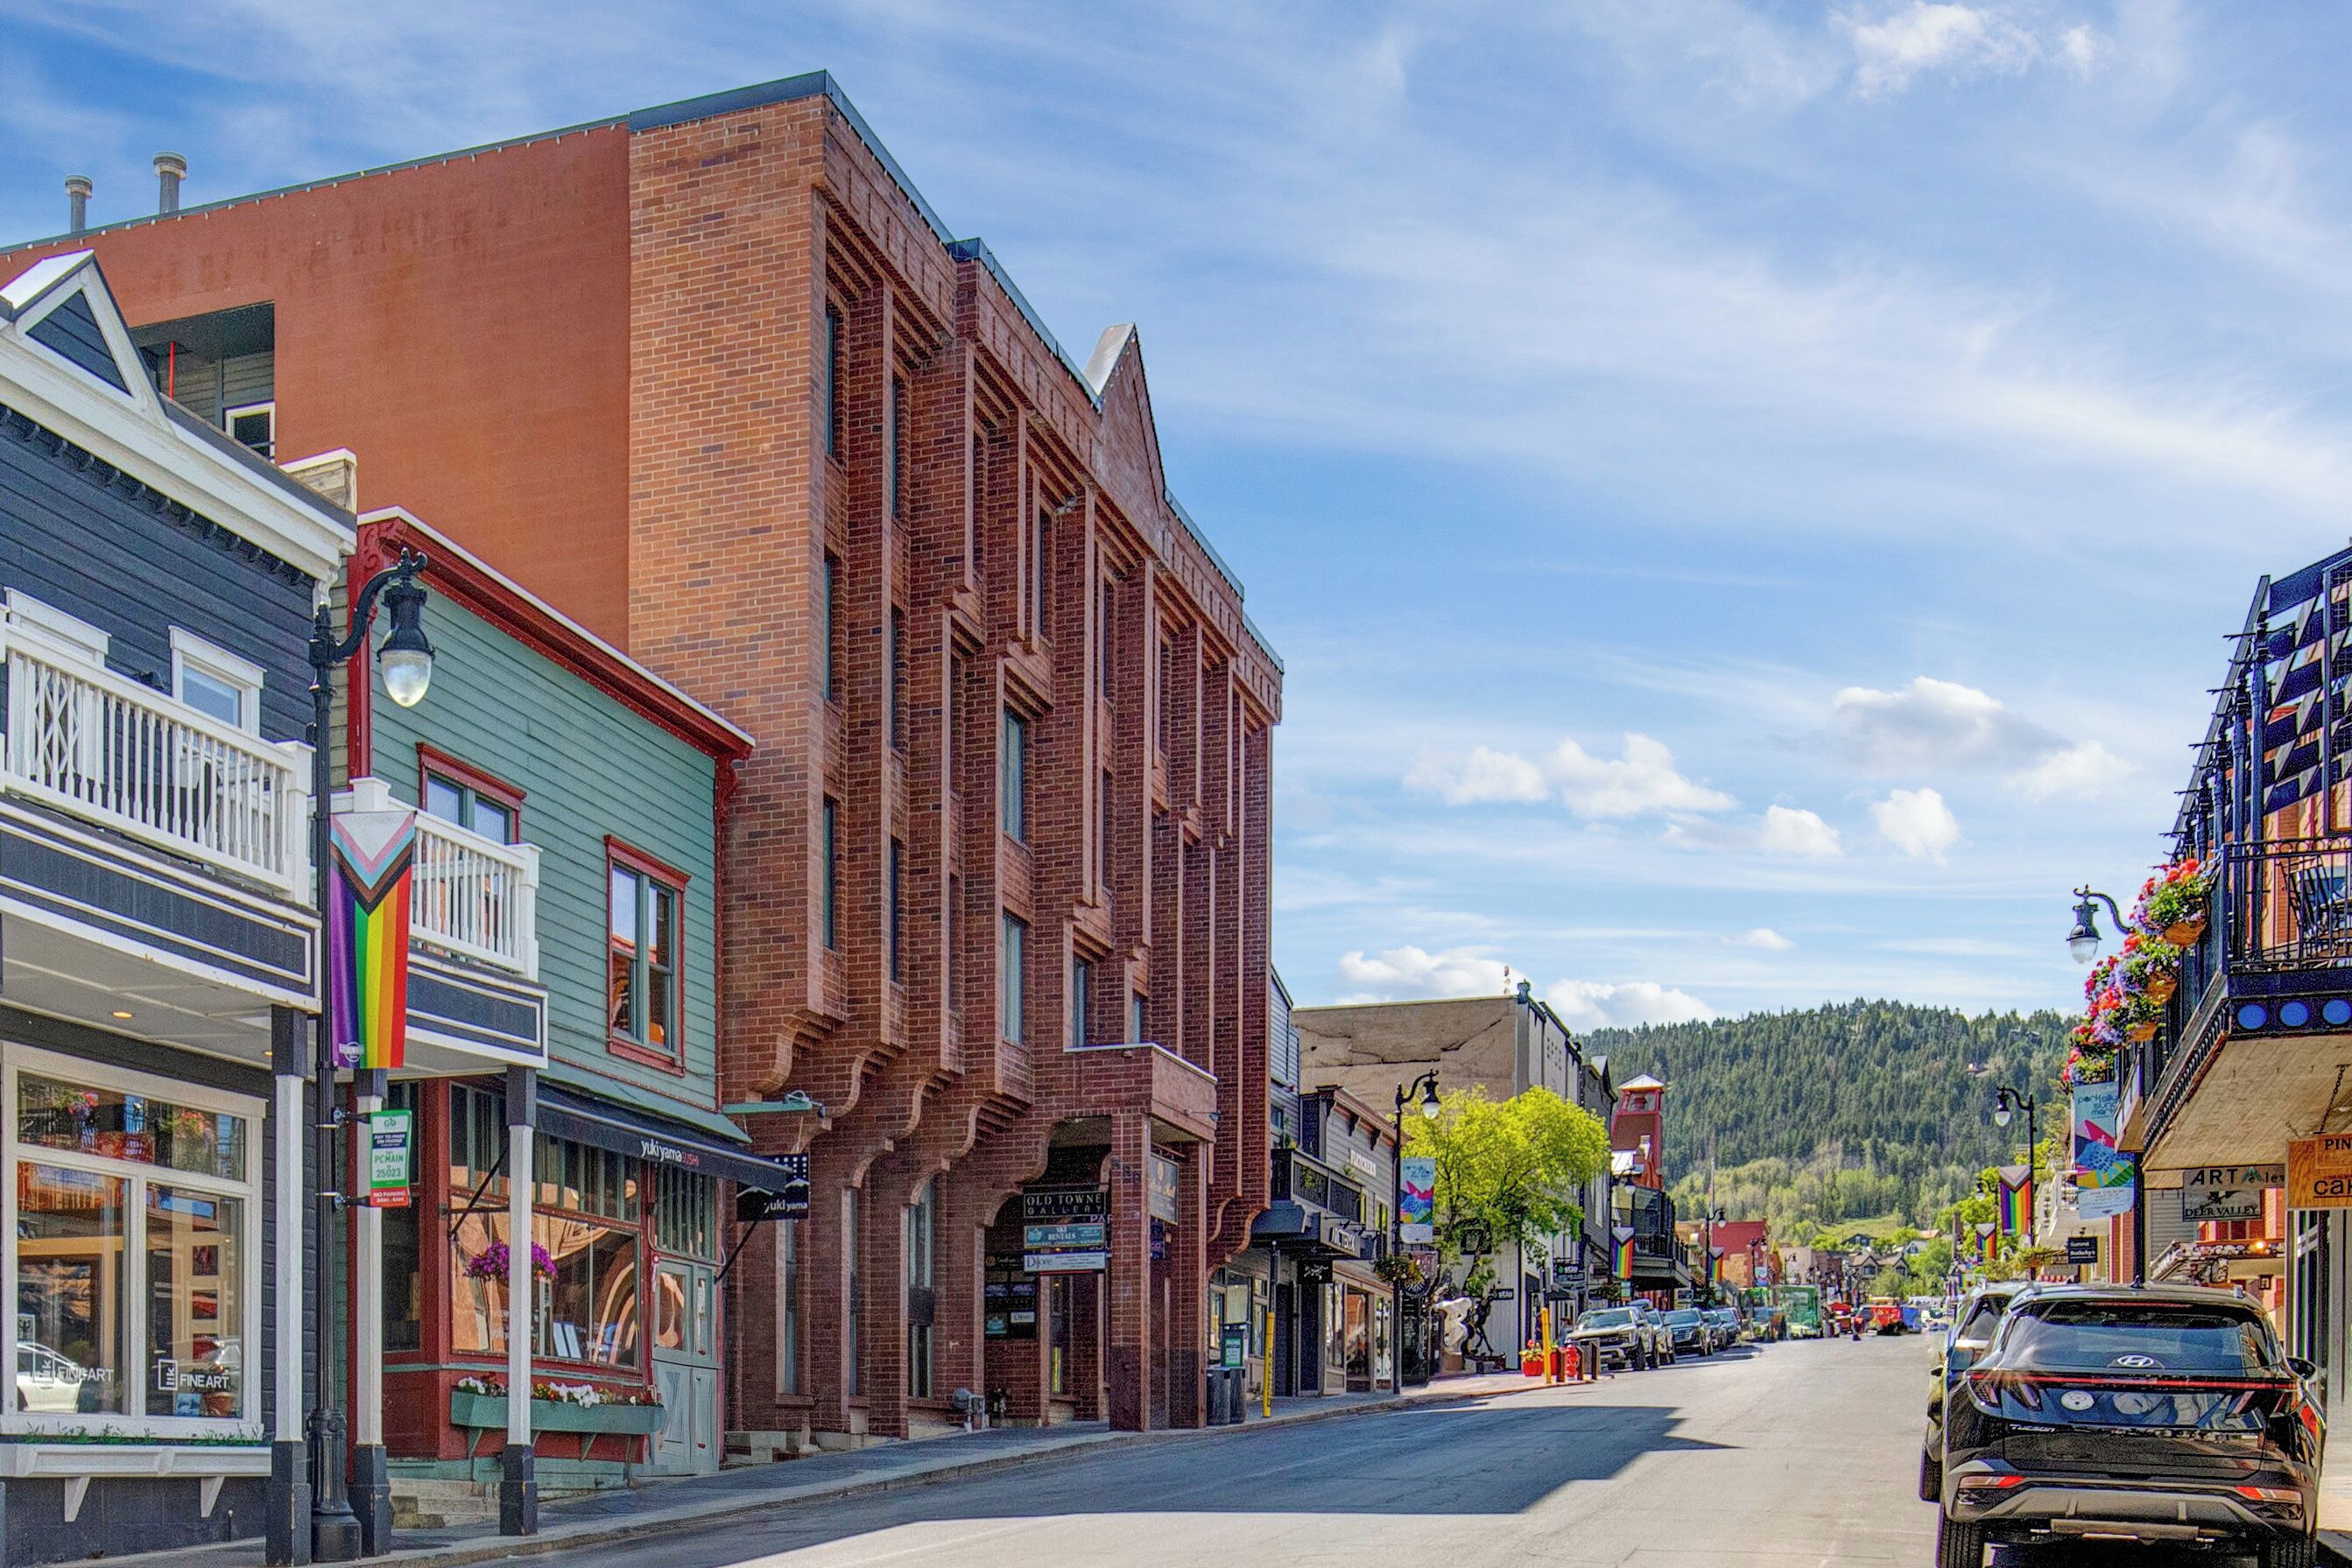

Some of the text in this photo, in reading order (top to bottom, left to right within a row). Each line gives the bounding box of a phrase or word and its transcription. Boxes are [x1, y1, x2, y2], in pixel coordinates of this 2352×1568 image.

[640, 1138, 659, 1157] yuki
[659, 1145, 682, 1162] yama
[376, 1169, 401, 1178] 25023
[2190, 1169, 2238, 1185] ART
[1026, 1194, 1102, 1206] OLD TOWNE
[1027, 1205, 1102, 1215] GALLERY
[2185, 1206, 2215, 1217] DEER
[1047, 1232, 1076, 1241] RENTALS
[88, 1368, 115, 1382] ART
[180, 1373, 205, 1387] FINE
[206, 1375, 229, 1389] ART
